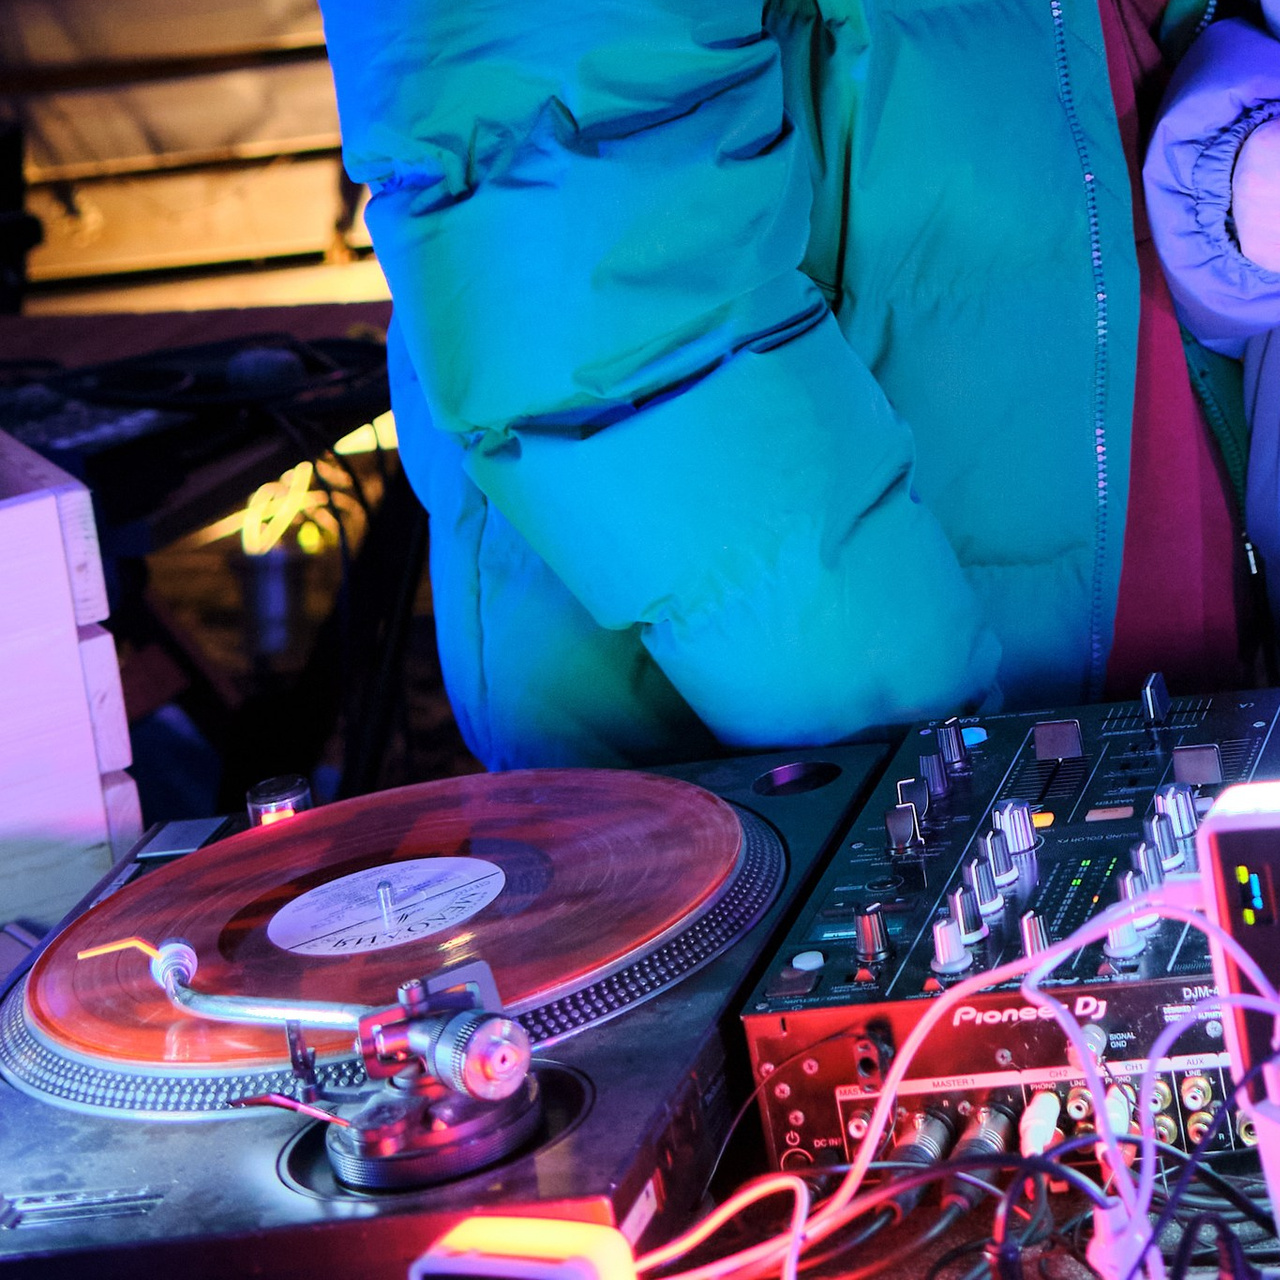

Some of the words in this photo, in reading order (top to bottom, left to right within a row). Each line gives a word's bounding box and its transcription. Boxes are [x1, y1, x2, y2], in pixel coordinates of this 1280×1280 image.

[1182, 986, 1220, 1000] DJM-4
[1109, 1032, 1136, 1041] SIGNAL
[1110, 1040, 1127, 1048] GND
[1186, 1057, 1204, 1066] AUX
[1125, 1062, 1144, 1072] CH1
[1050, 1069, 1069, 1078] CH2
[932, 1078, 968, 1088] MASTER
[1030, 1082, 1057, 1090] PHONO
[1070, 1079, 1086, 1087] LINE
[814, 1138, 828, 1148] DC
